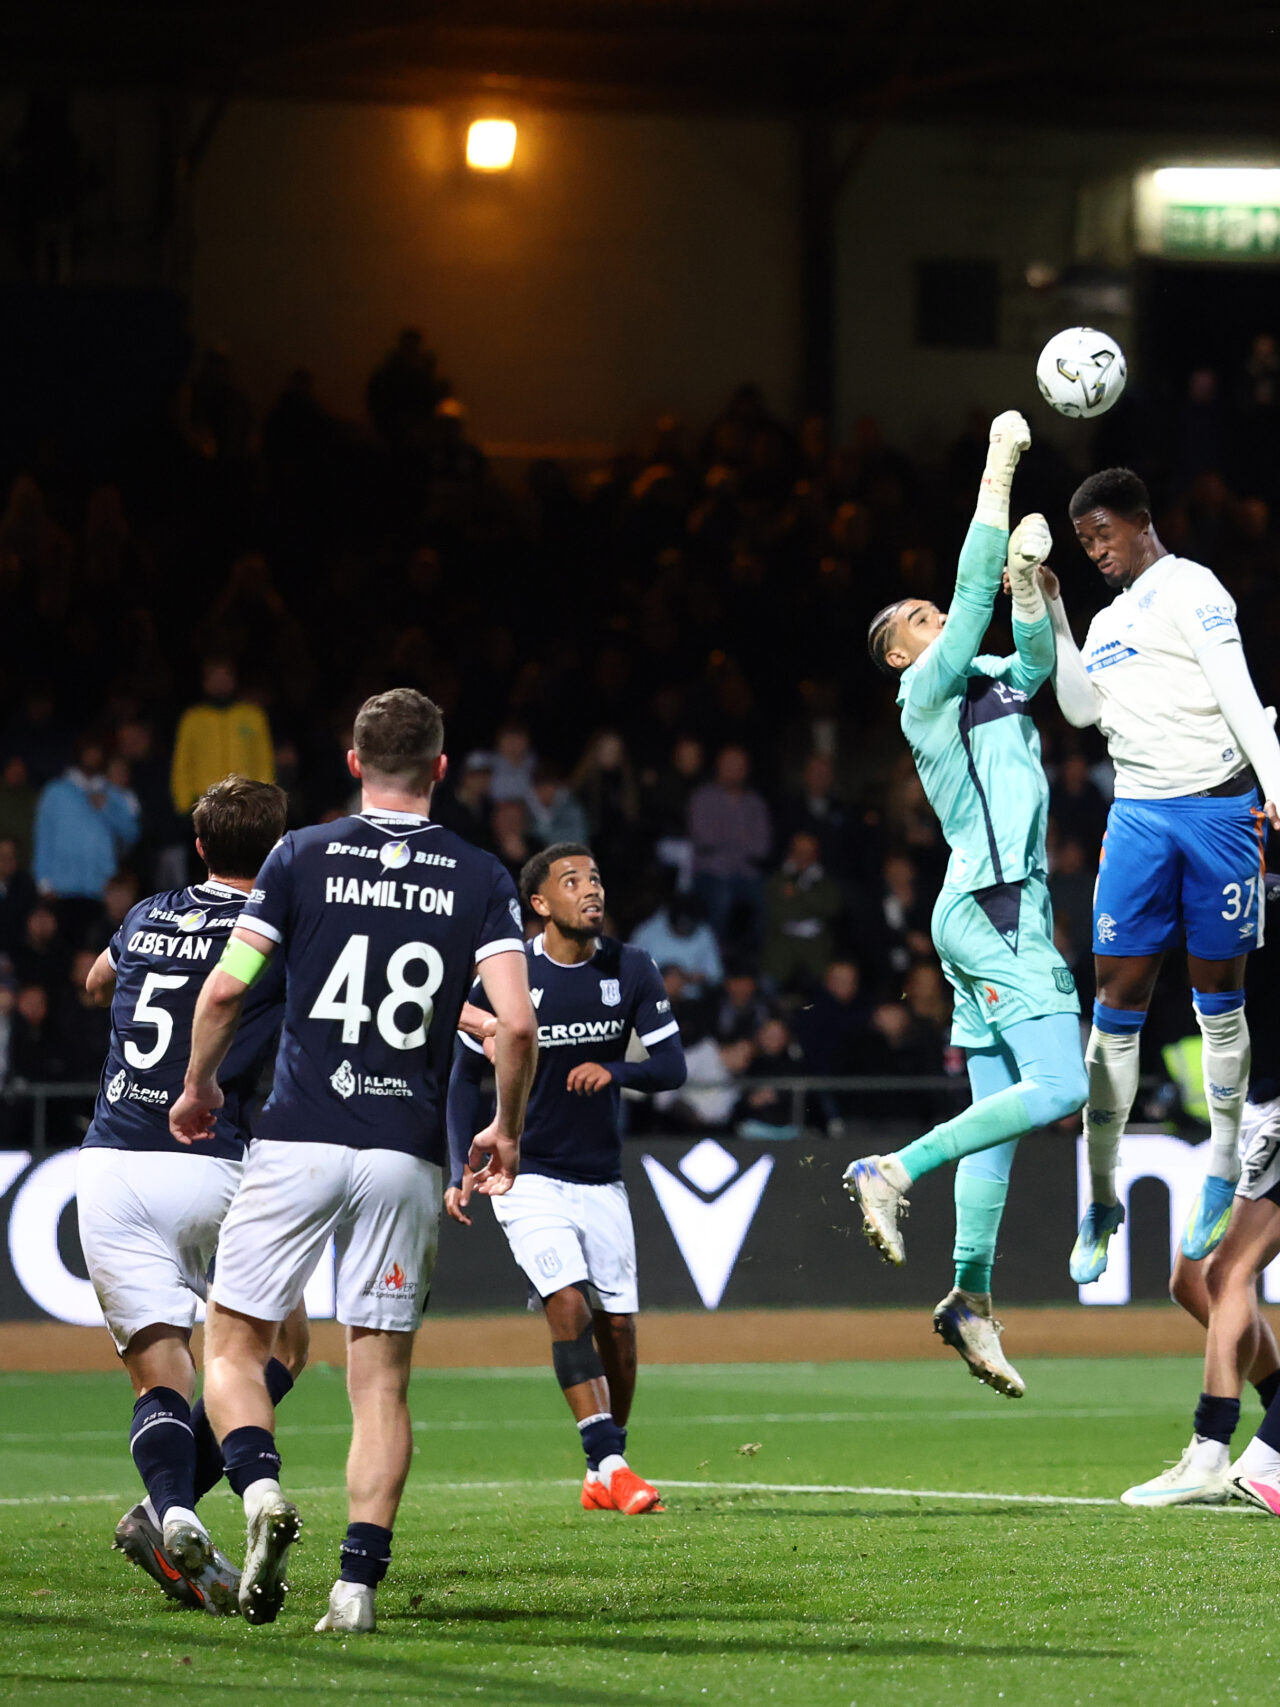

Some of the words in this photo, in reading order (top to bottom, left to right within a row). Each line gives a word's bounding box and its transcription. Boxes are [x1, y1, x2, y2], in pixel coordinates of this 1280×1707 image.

[325, 842, 378, 860] Drain
[413, 851, 457, 869] Blitz
[325, 876, 455, 917] HAMILTON
[1221, 876, 1256, 921] 37
[148, 906, 181, 923] Drain
[308, 934, 445, 1051] 48
[123, 971, 190, 1070] 5
[537, 1018, 625, 1041] CROWN
[364, 1086, 414, 1097] PROJECTS
